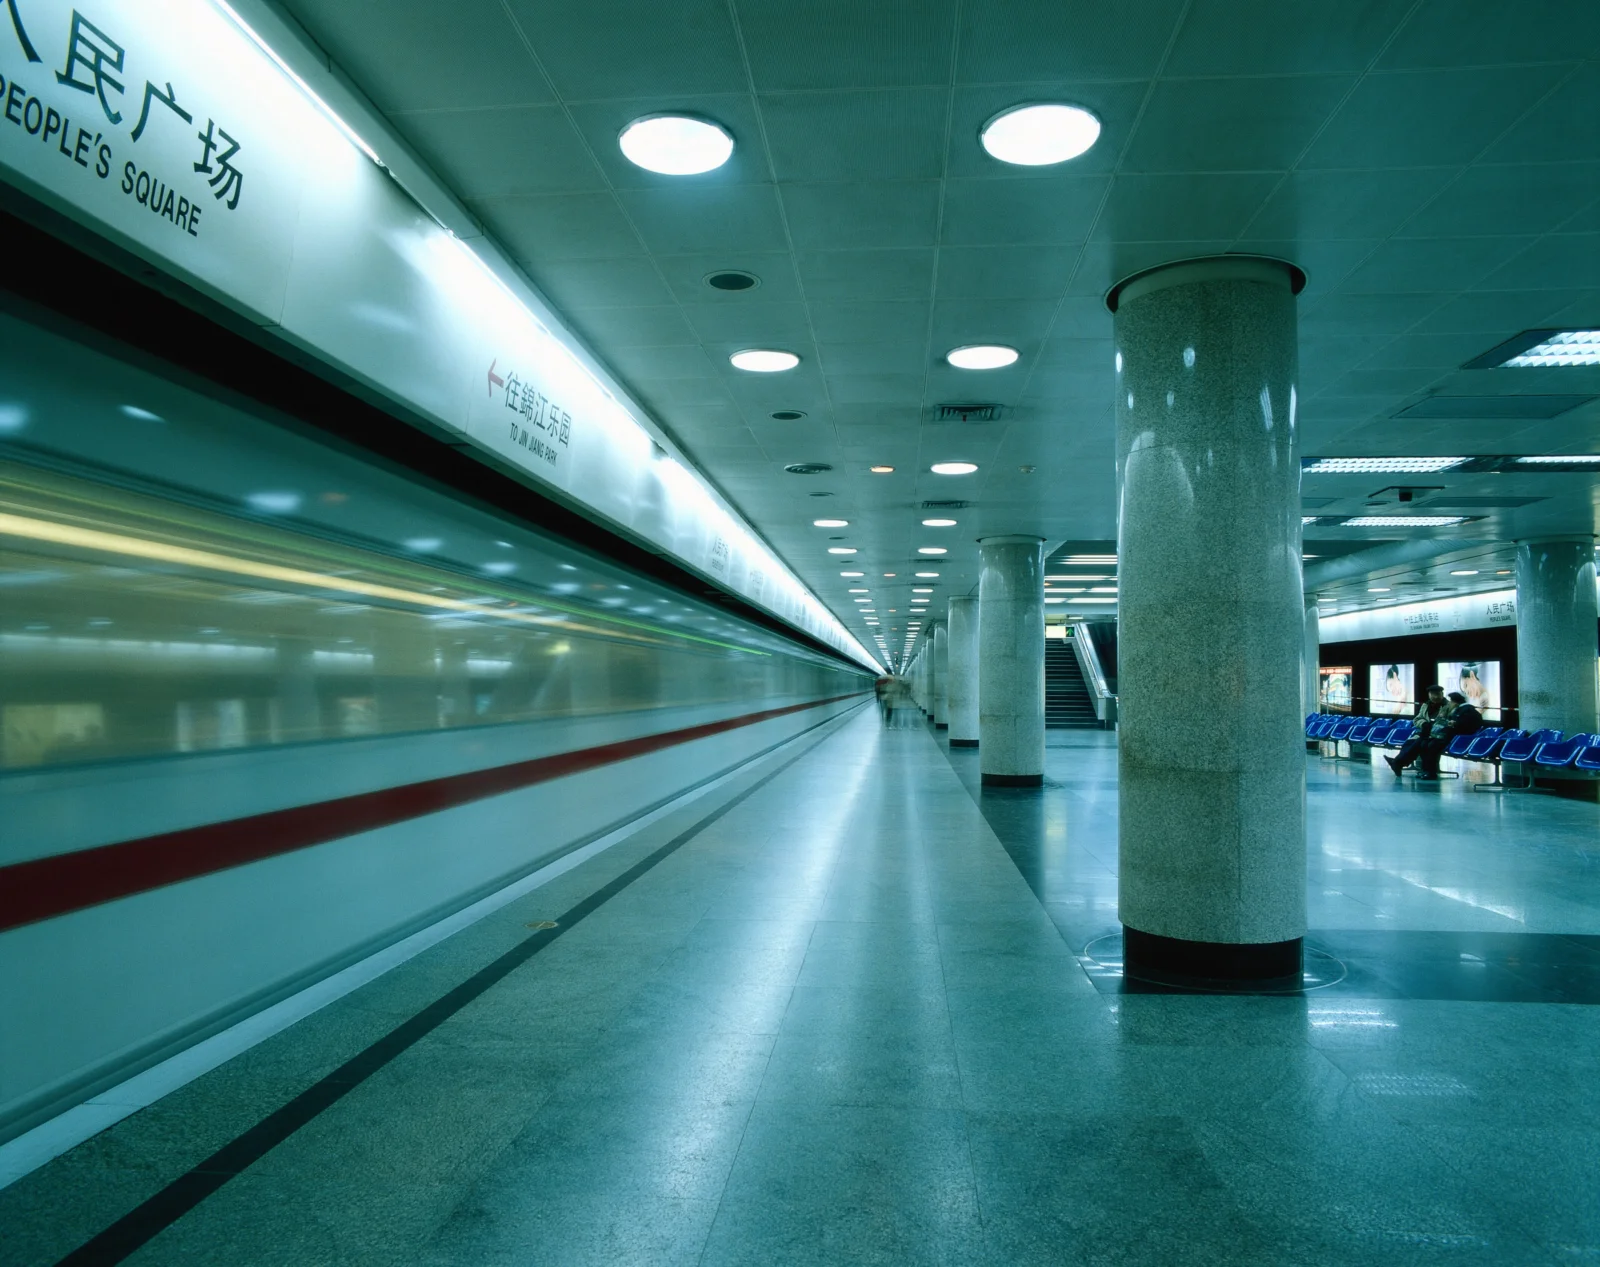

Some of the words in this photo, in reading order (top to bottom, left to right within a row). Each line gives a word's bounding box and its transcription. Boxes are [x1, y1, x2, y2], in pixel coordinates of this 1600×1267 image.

[121, 161, 202, 237] SQUARE
[510, 422, 518, 441] TO
[544, 446, 558, 467] PARK
